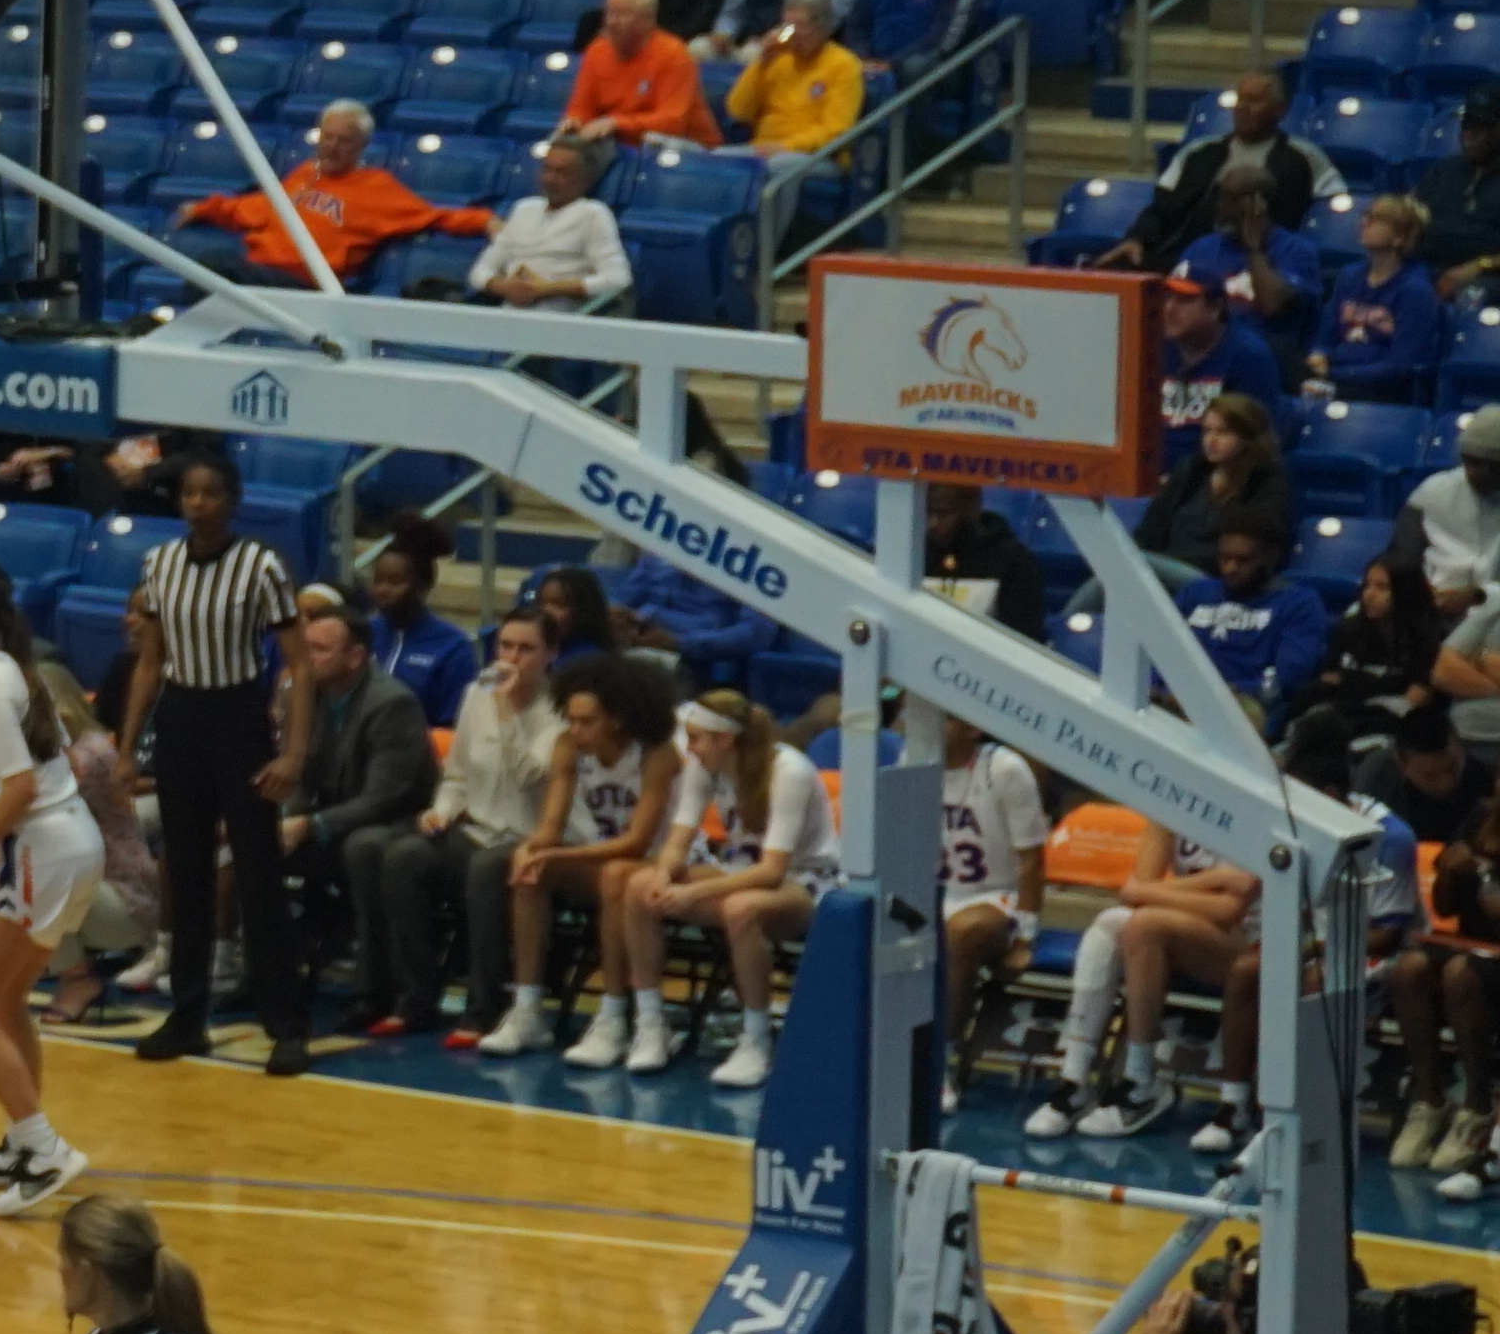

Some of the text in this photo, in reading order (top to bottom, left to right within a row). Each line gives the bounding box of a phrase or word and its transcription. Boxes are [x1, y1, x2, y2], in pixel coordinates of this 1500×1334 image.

[900, 380, 1037, 419] MAVERICKS
[862, 447, 1078, 484] UTA MAVERICKS
[579, 462, 789, 601] Schelde
[929, 652, 1238, 835] COLLEGE PARK CENTER
[940, 804, 983, 837] TA
[939, 842, 987, 883] 3
